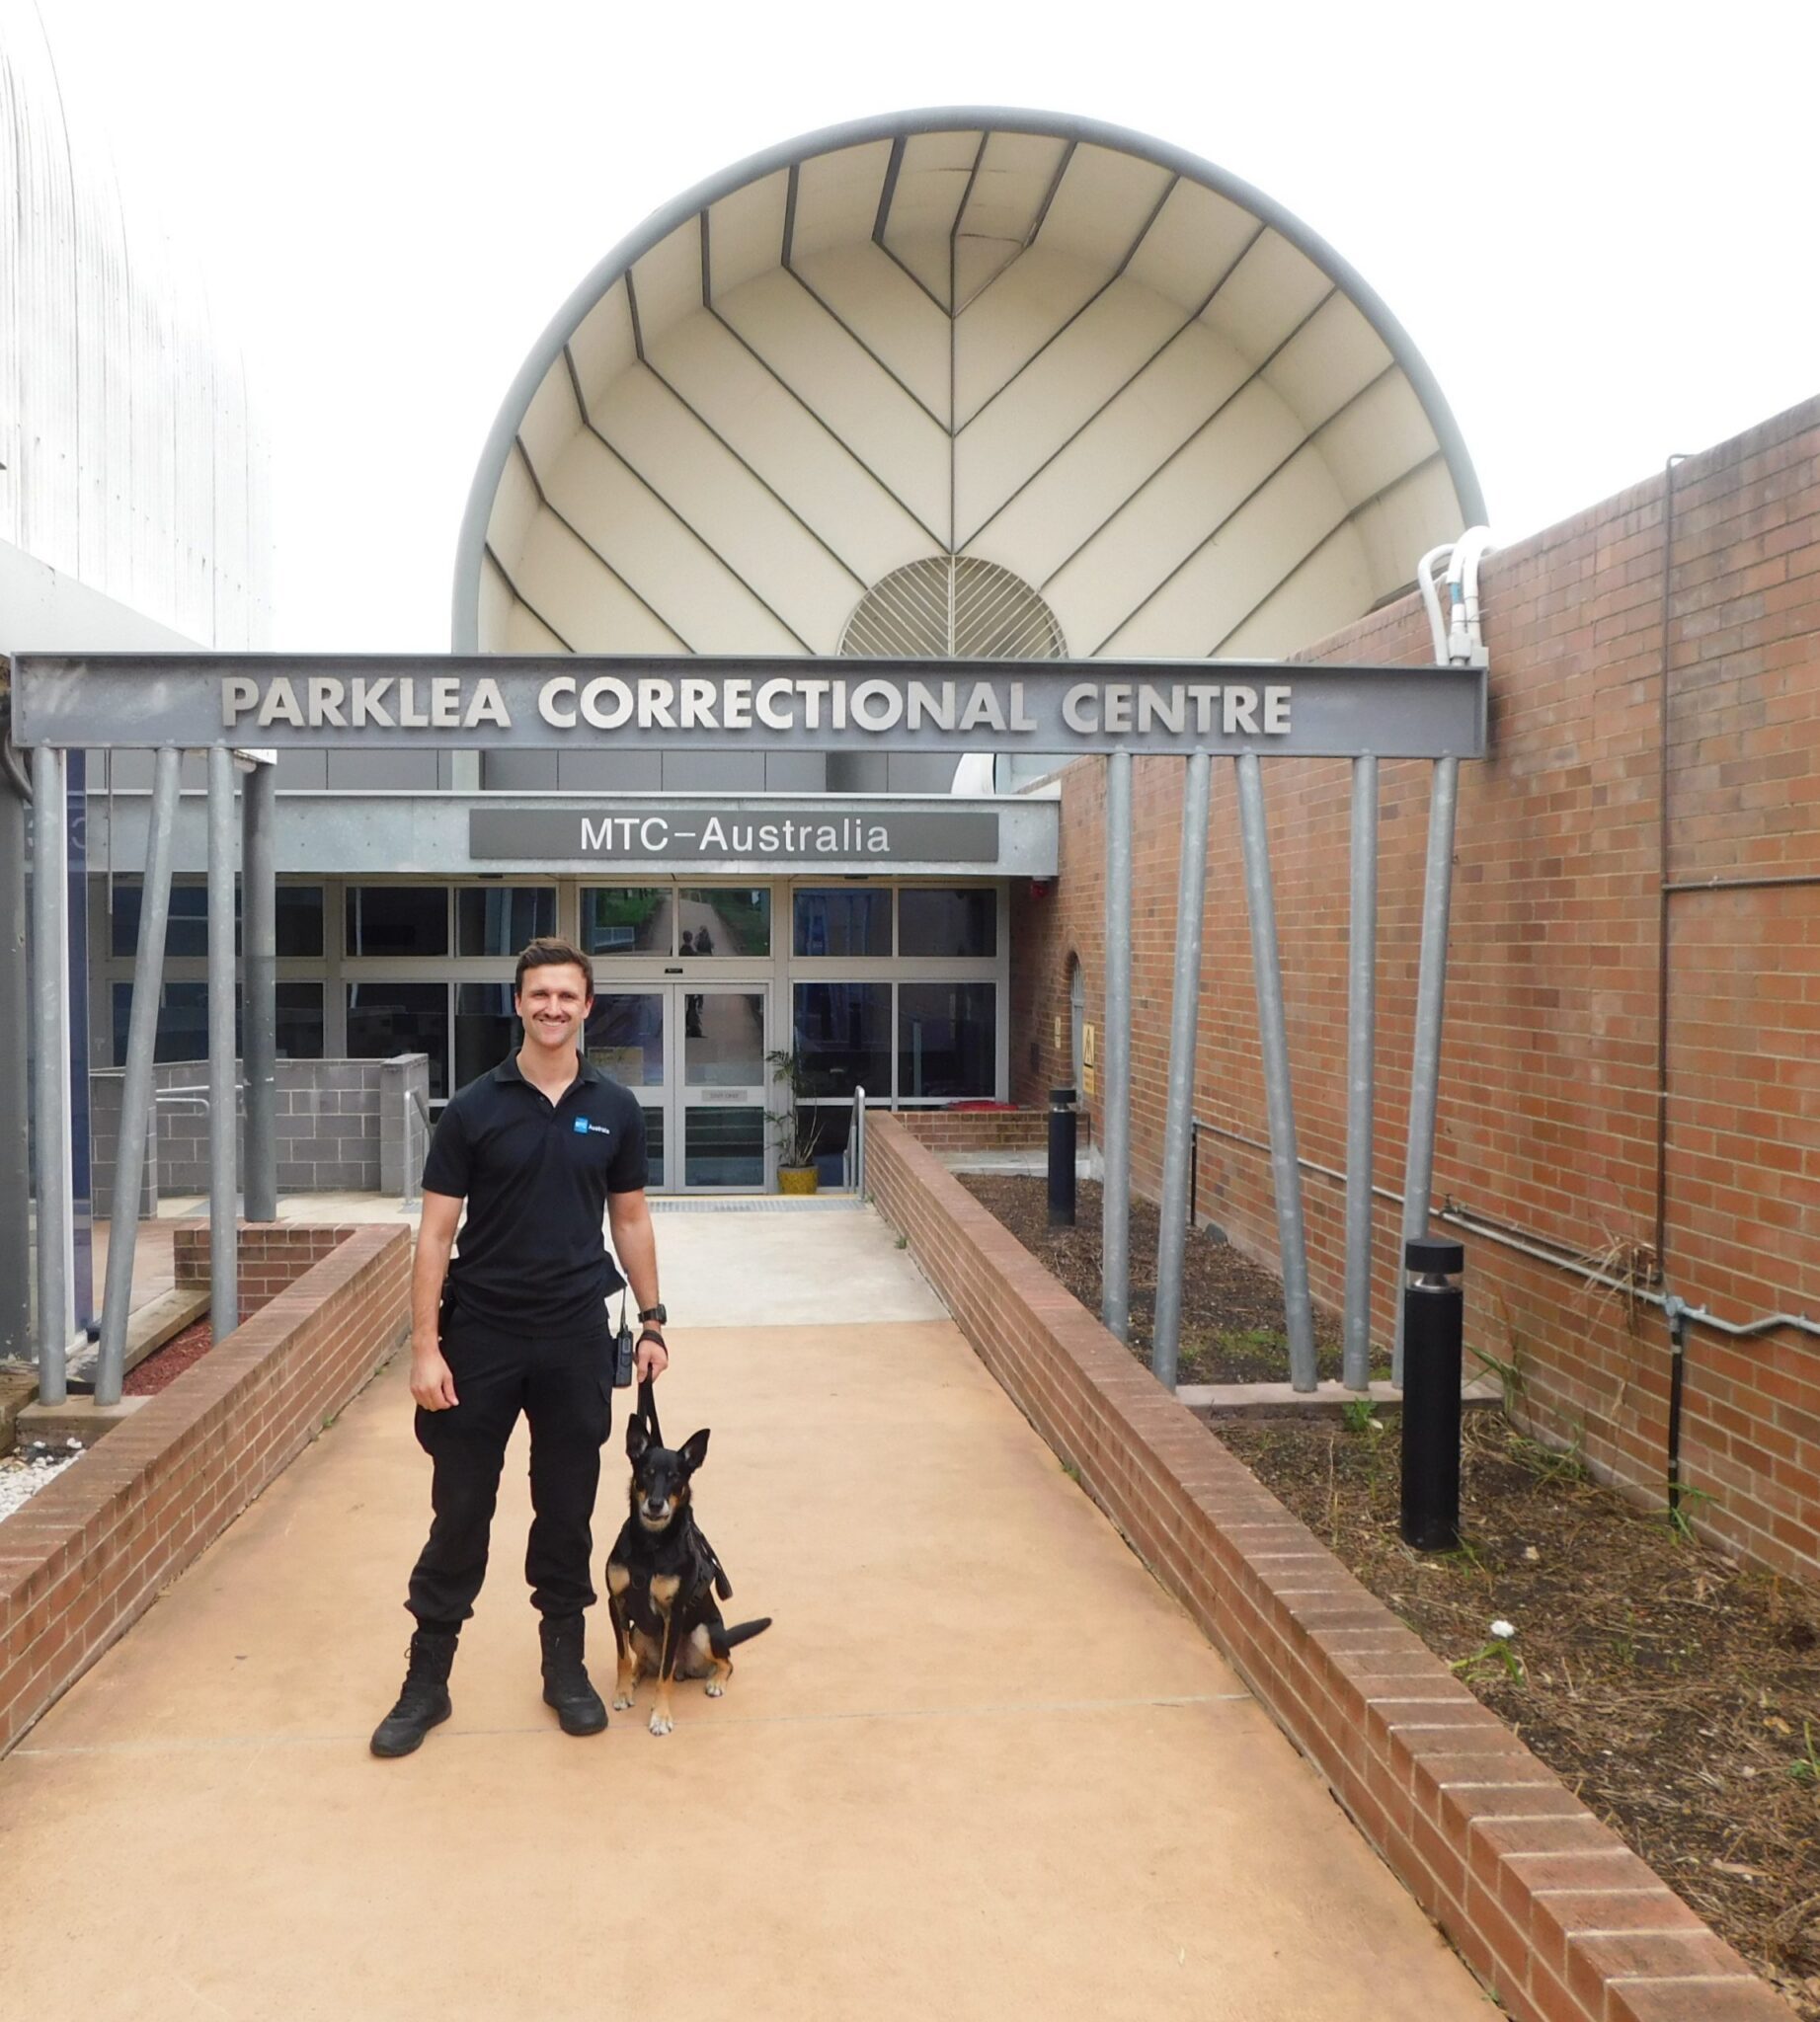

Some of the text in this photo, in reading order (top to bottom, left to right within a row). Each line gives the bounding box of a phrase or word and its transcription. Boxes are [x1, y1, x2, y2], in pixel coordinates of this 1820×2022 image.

[221, 676, 1292, 737] PARKLEA CORRECTIONAL CENTRE
